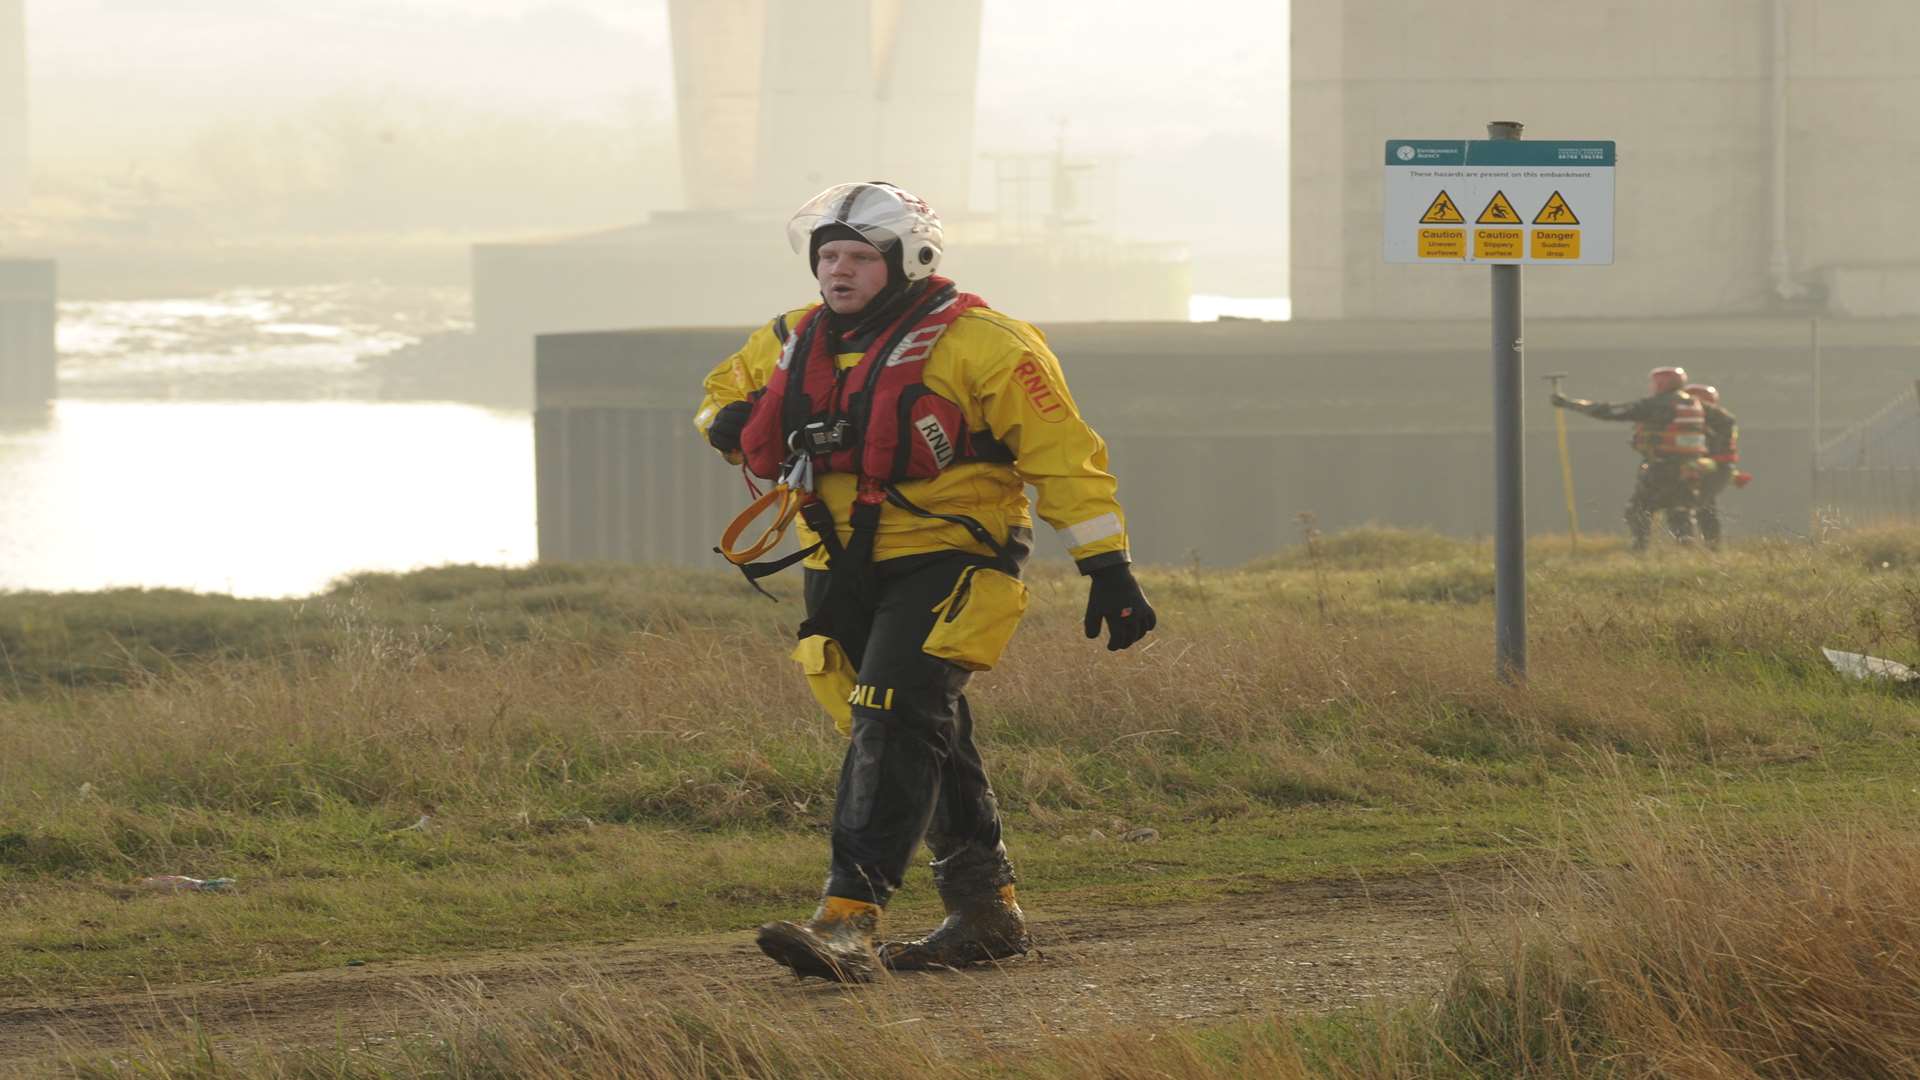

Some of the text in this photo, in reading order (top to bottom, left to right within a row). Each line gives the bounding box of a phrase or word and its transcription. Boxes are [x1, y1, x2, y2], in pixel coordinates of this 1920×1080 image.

[1479, 171, 1508, 179] present
[1422, 231, 1463, 239] Caution
[1478, 231, 1519, 240] Caution
[1536, 231, 1575, 241] Danger
[1014, 360, 1063, 414] RNLI
[922, 422, 953, 466] RNLI
